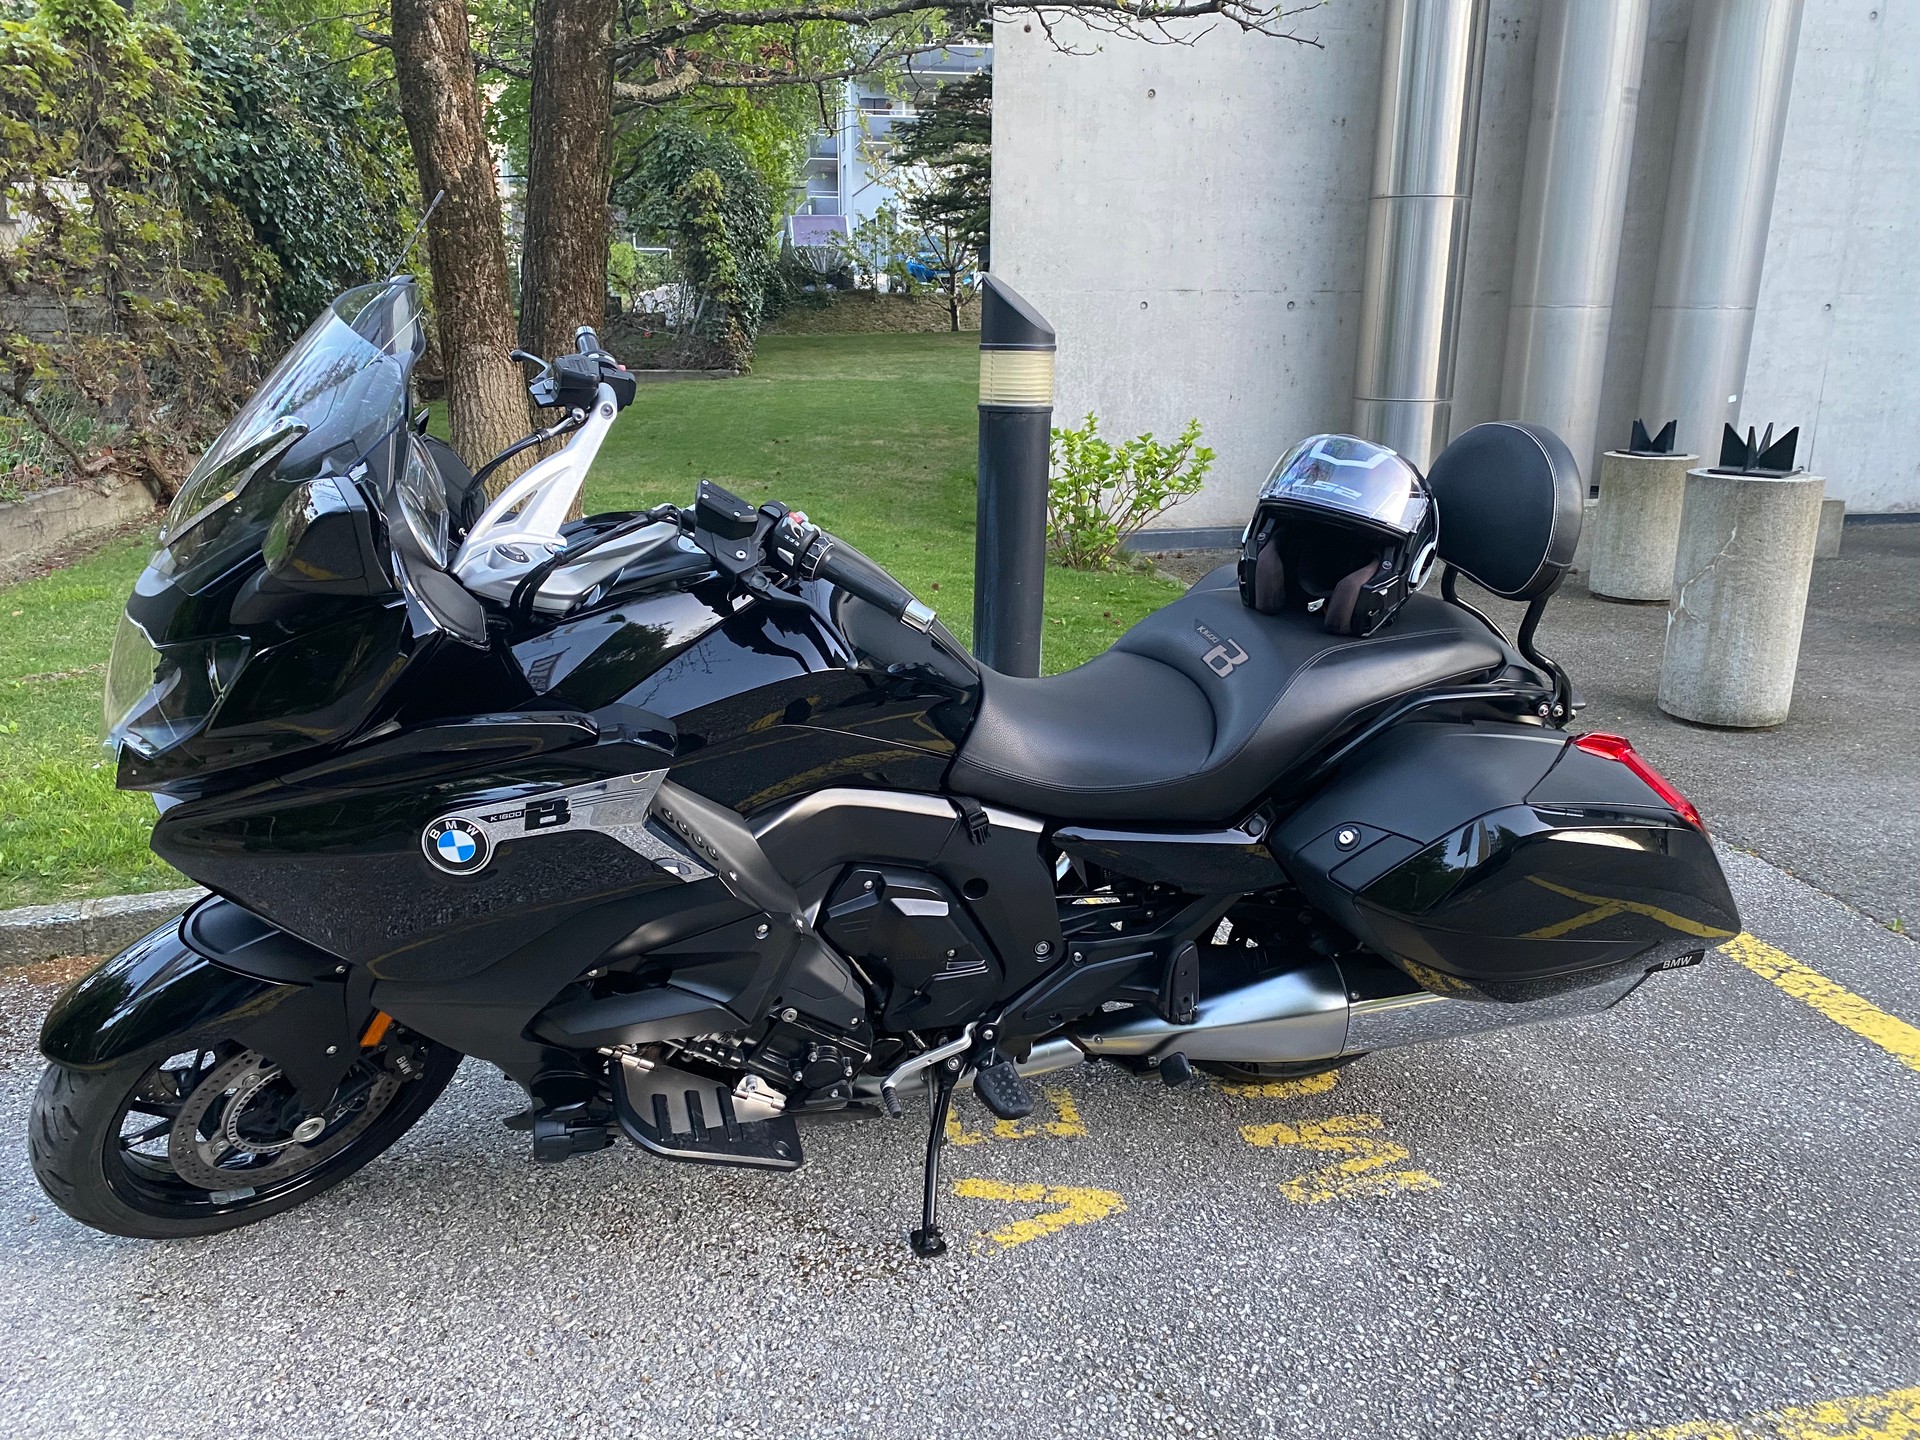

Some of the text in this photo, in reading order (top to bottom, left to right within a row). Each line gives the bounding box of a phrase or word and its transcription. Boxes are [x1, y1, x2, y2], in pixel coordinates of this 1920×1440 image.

[1292, 478, 1362, 501] LS2
[1202, 638, 1249, 678] B
[428, 820, 479, 840] BMW
[1662, 955, 1693, 970] BMW
[396, 1055, 413, 1075] BMW
